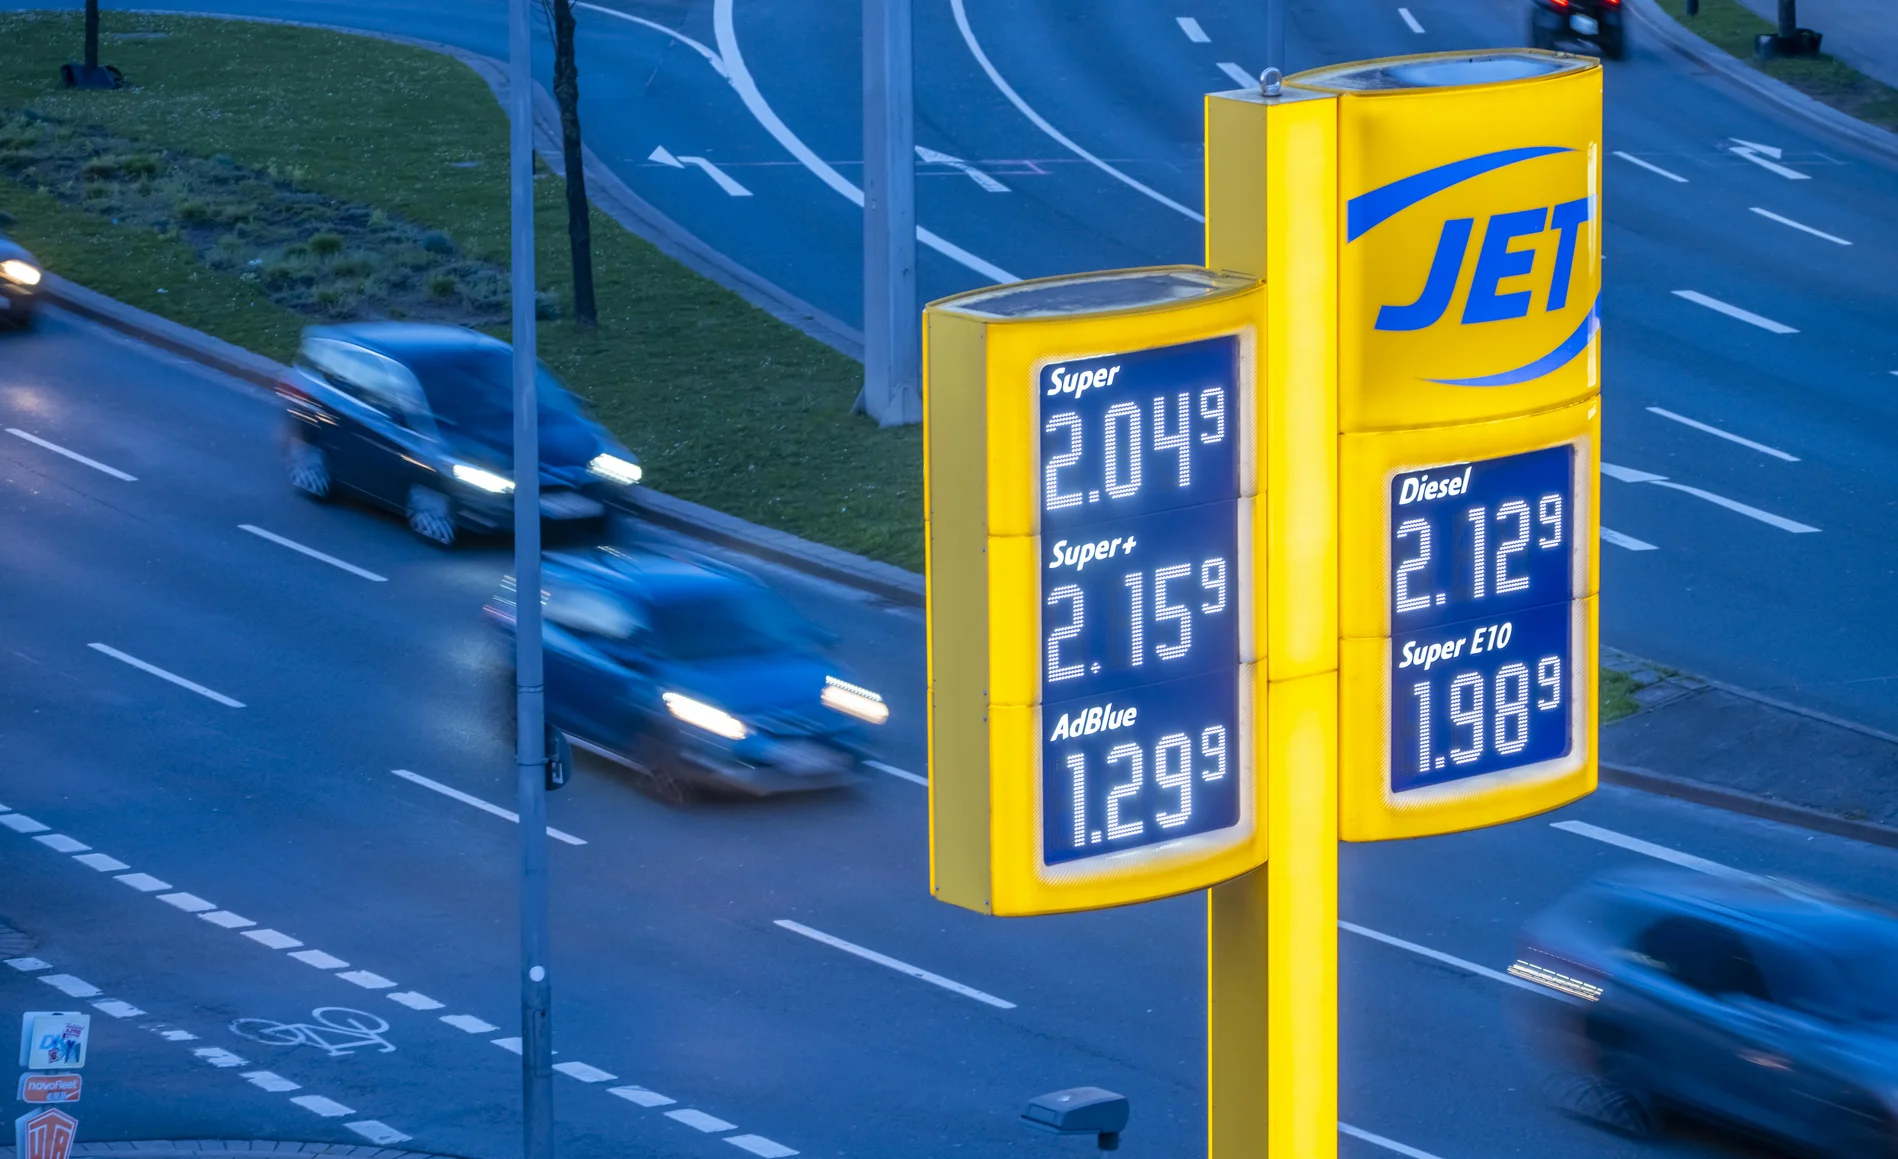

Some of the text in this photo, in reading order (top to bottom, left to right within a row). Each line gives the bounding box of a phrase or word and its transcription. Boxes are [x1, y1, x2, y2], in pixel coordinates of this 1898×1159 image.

[1374, 193, 1598, 331] JET
[1047, 366, 1120, 399] Super
[1399, 466, 1472, 505] Diesel
[1049, 536, 1137, 571] Super+
[1399, 622, 1513, 670] Super E10
[1050, 703, 1137, 742] AdBlue
[28, 1080, 77, 1091] novofleet
